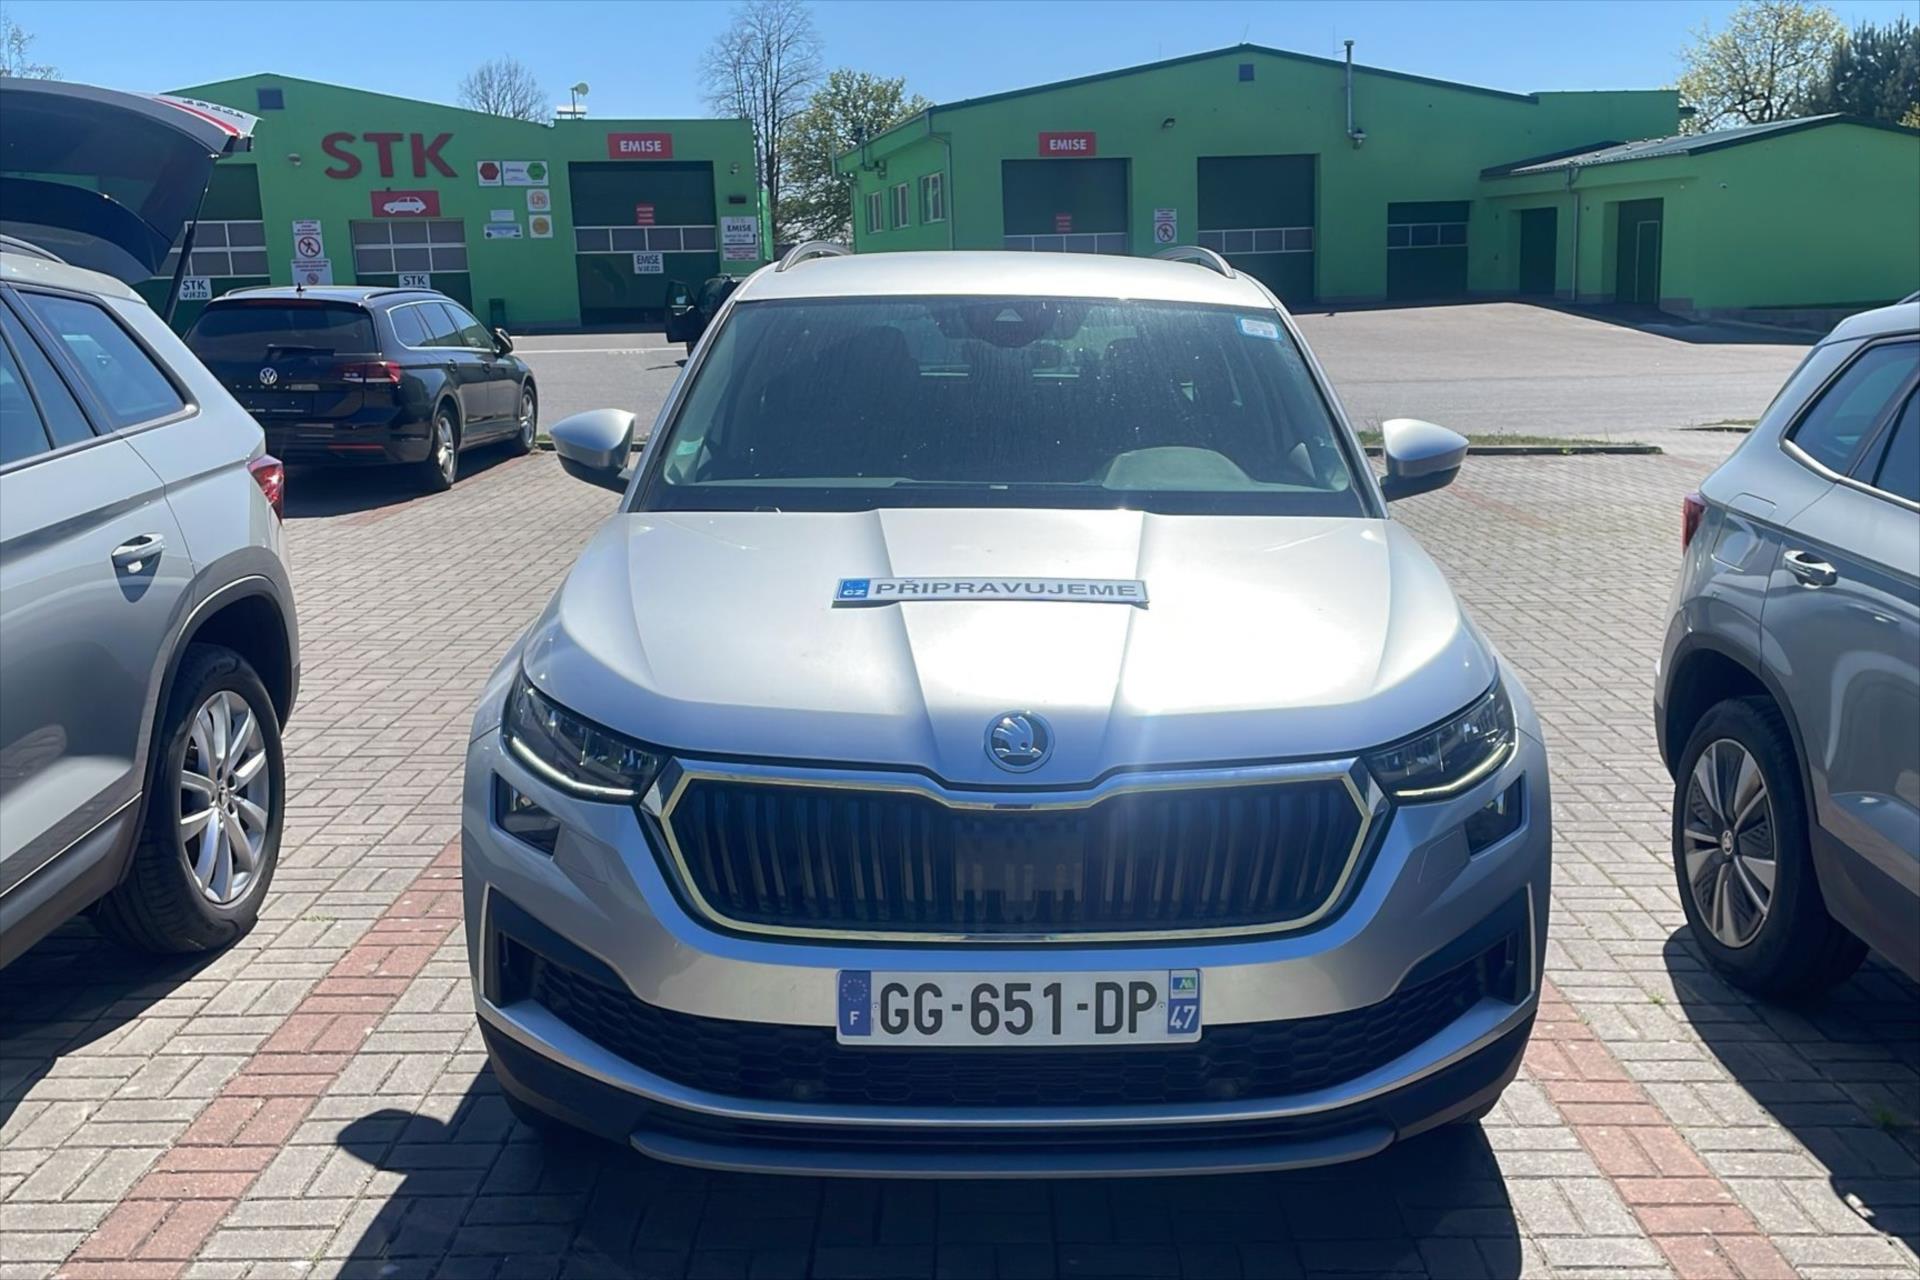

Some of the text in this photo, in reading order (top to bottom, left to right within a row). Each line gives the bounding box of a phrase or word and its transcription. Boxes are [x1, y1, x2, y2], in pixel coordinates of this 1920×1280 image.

[620, 140, 662, 152] EMISE
[1050, 139, 1088, 150] EMISE
[321, 132, 458, 179] STK
[637, 254, 661, 265] EMISE
[182, 279, 206, 290] STK
[403, 275, 426, 286] STK
[876, 579, 1138, 597] PŘIPRAVUJEME
[879, 981, 1158, 1035] GG-651-DP
[850, 1011, 860, 1026] F
[1170, 1004, 1197, 1029] 47
